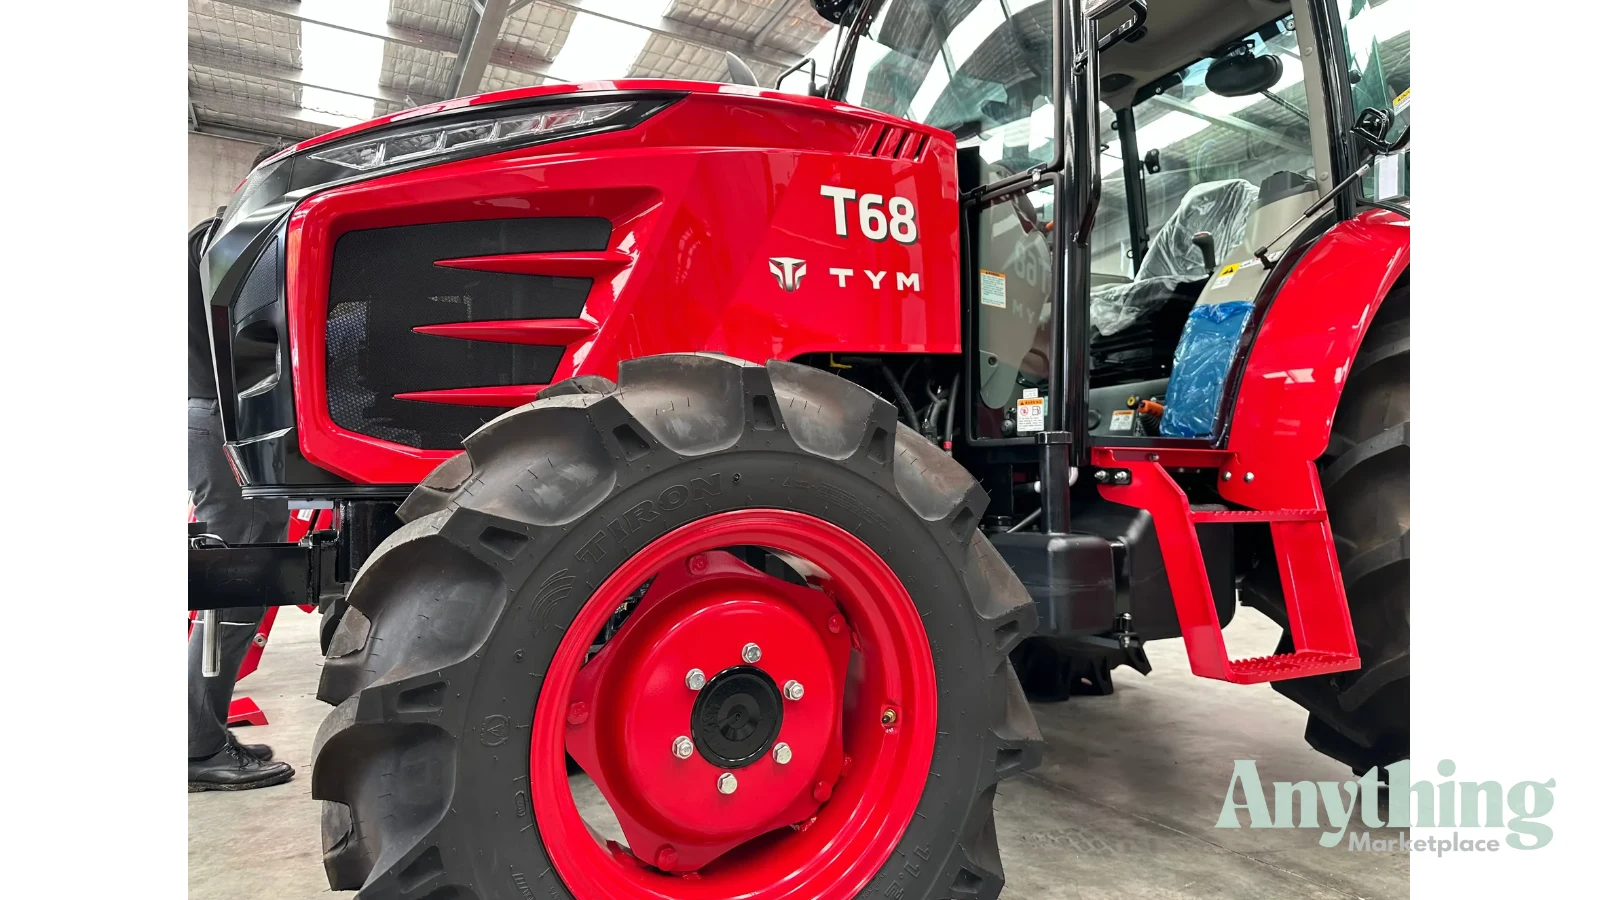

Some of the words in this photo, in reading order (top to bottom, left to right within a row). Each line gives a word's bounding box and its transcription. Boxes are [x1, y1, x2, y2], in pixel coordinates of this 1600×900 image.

[820, 185, 918, 245] T68
[829, 267, 921, 292] TYM
[574, 472, 723, 563] TIRON
